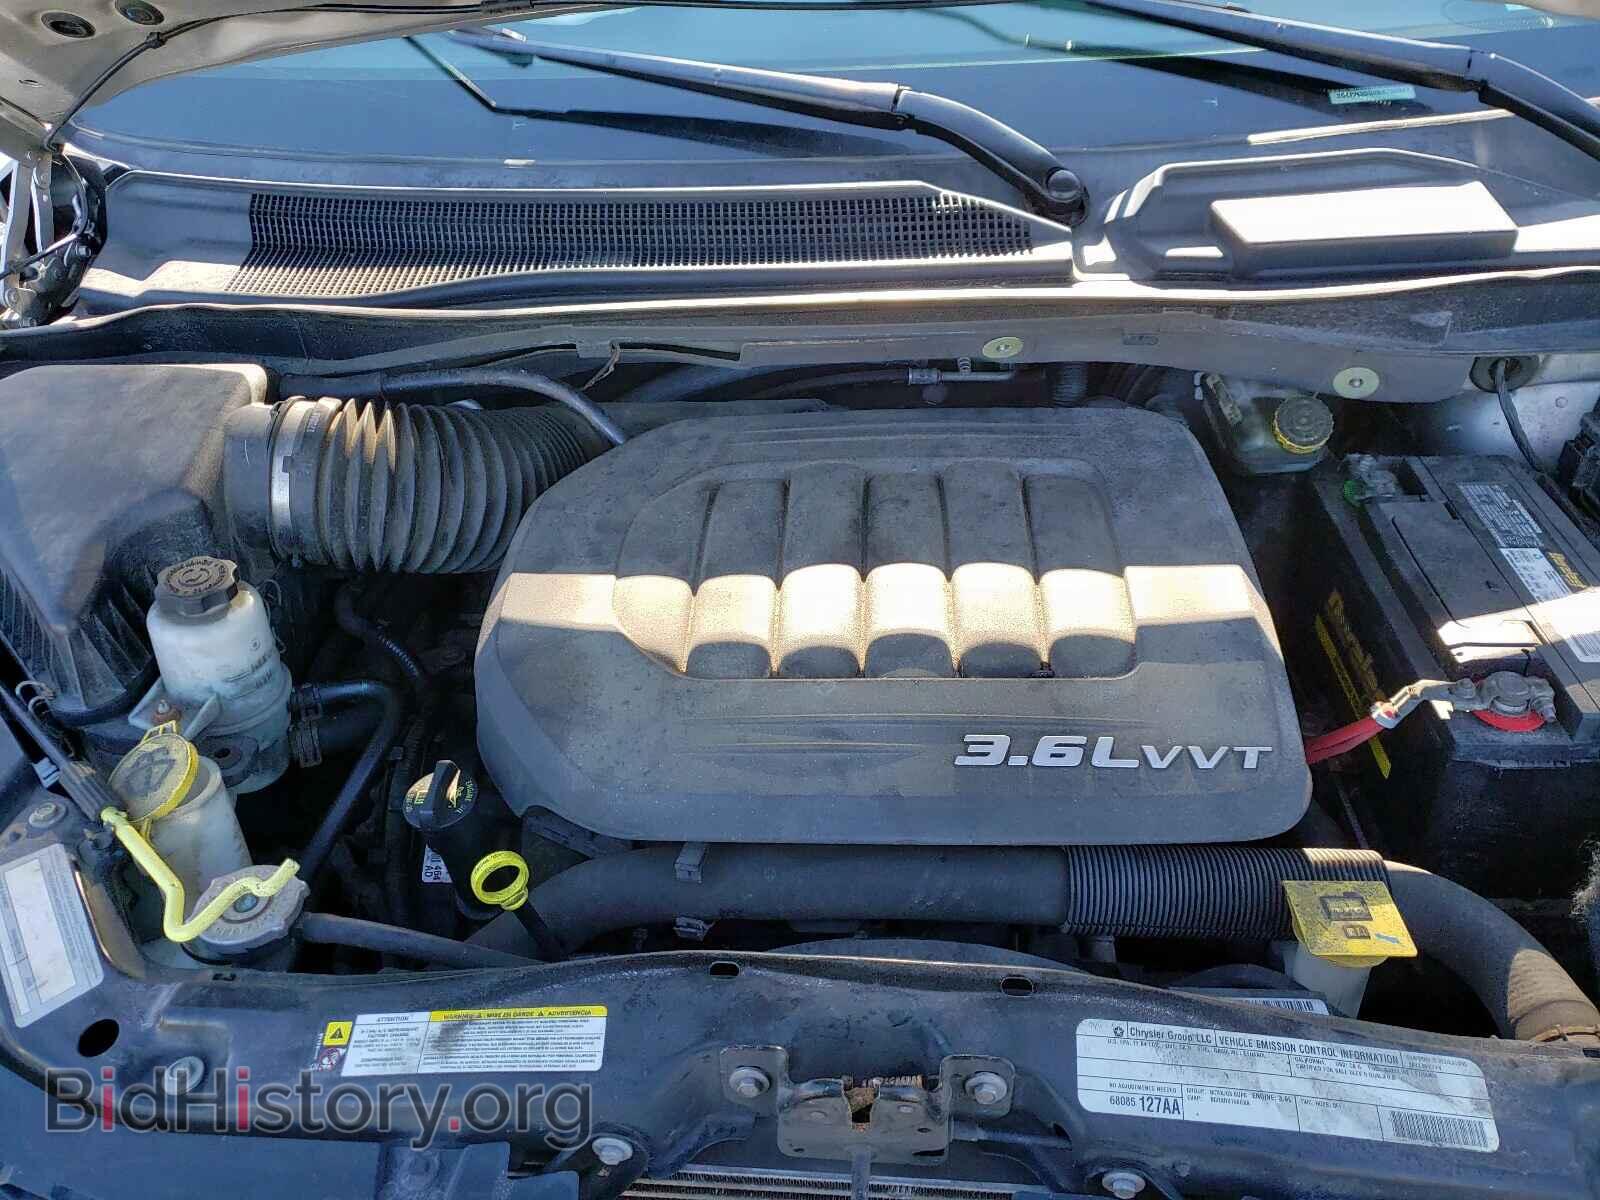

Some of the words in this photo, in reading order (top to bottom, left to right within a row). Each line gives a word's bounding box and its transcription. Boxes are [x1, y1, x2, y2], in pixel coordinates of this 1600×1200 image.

[548, 1009, 592, 1017] ADVERTENCIA
[1129, 1026, 1164, 1040] Chrysler
[1167, 1032, 1193, 1043] Group
[1196, 1034, 1212, 1044] LLC
[1218, 1035, 1253, 1049] VEHICLE
[1256, 1040, 1297, 1053] EMISSION
[1299, 1044, 1338, 1058] CONTROL
[1341, 1048, 1399, 1065] INFORMATION
[1109, 1095, 1136, 1107] 68085
[1139, 1096, 1181, 1115] 127AA
